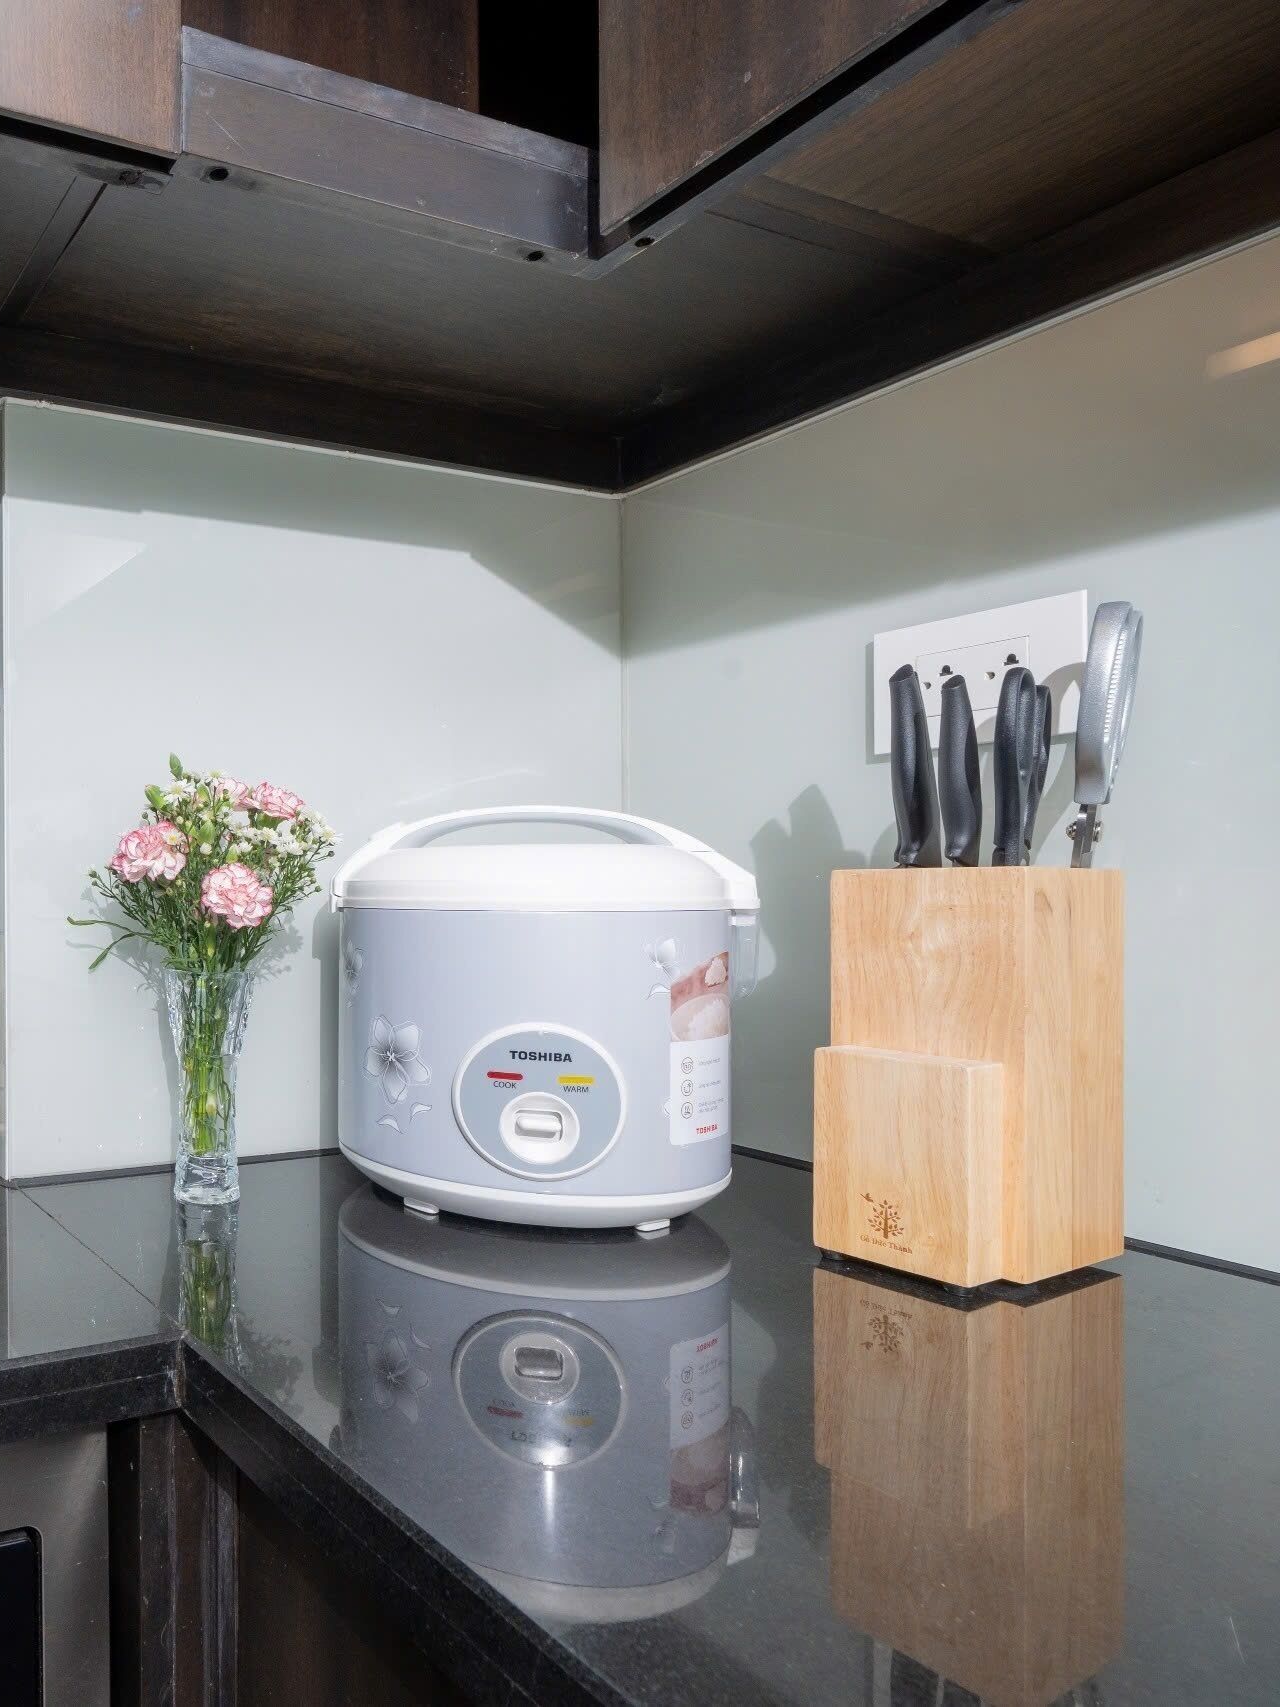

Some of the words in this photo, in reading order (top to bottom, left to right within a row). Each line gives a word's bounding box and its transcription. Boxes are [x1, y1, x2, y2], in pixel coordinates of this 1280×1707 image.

[509, 1050, 573, 1063] TOSHIBA
[493, 1080, 517, 1090] COOK
[563, 1085, 589, 1094] WARM
[696, 1123, 718, 1135] TOSHIBA
